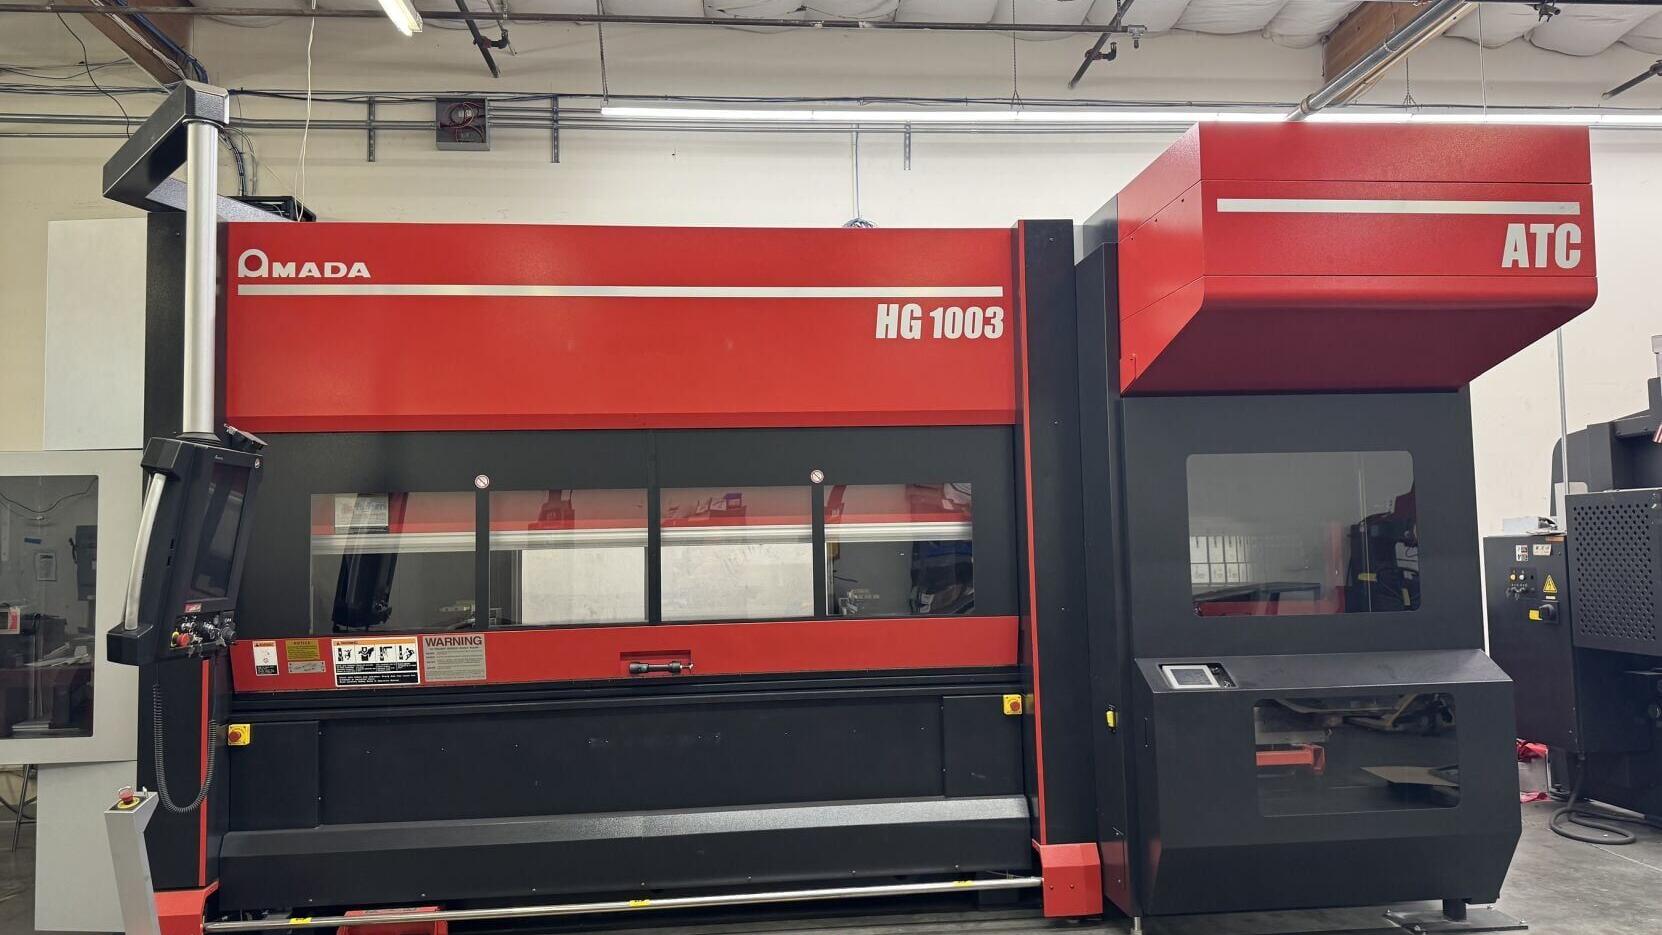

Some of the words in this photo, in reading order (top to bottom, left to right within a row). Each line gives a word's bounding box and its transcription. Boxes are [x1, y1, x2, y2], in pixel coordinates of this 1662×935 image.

[1502, 222, 1581, 269] ATC
[238, 248, 371, 278] AMADA
[876, 303, 922, 340] HG
[930, 306, 1004, 339] 1003
[425, 636, 482, 647] WARNING
